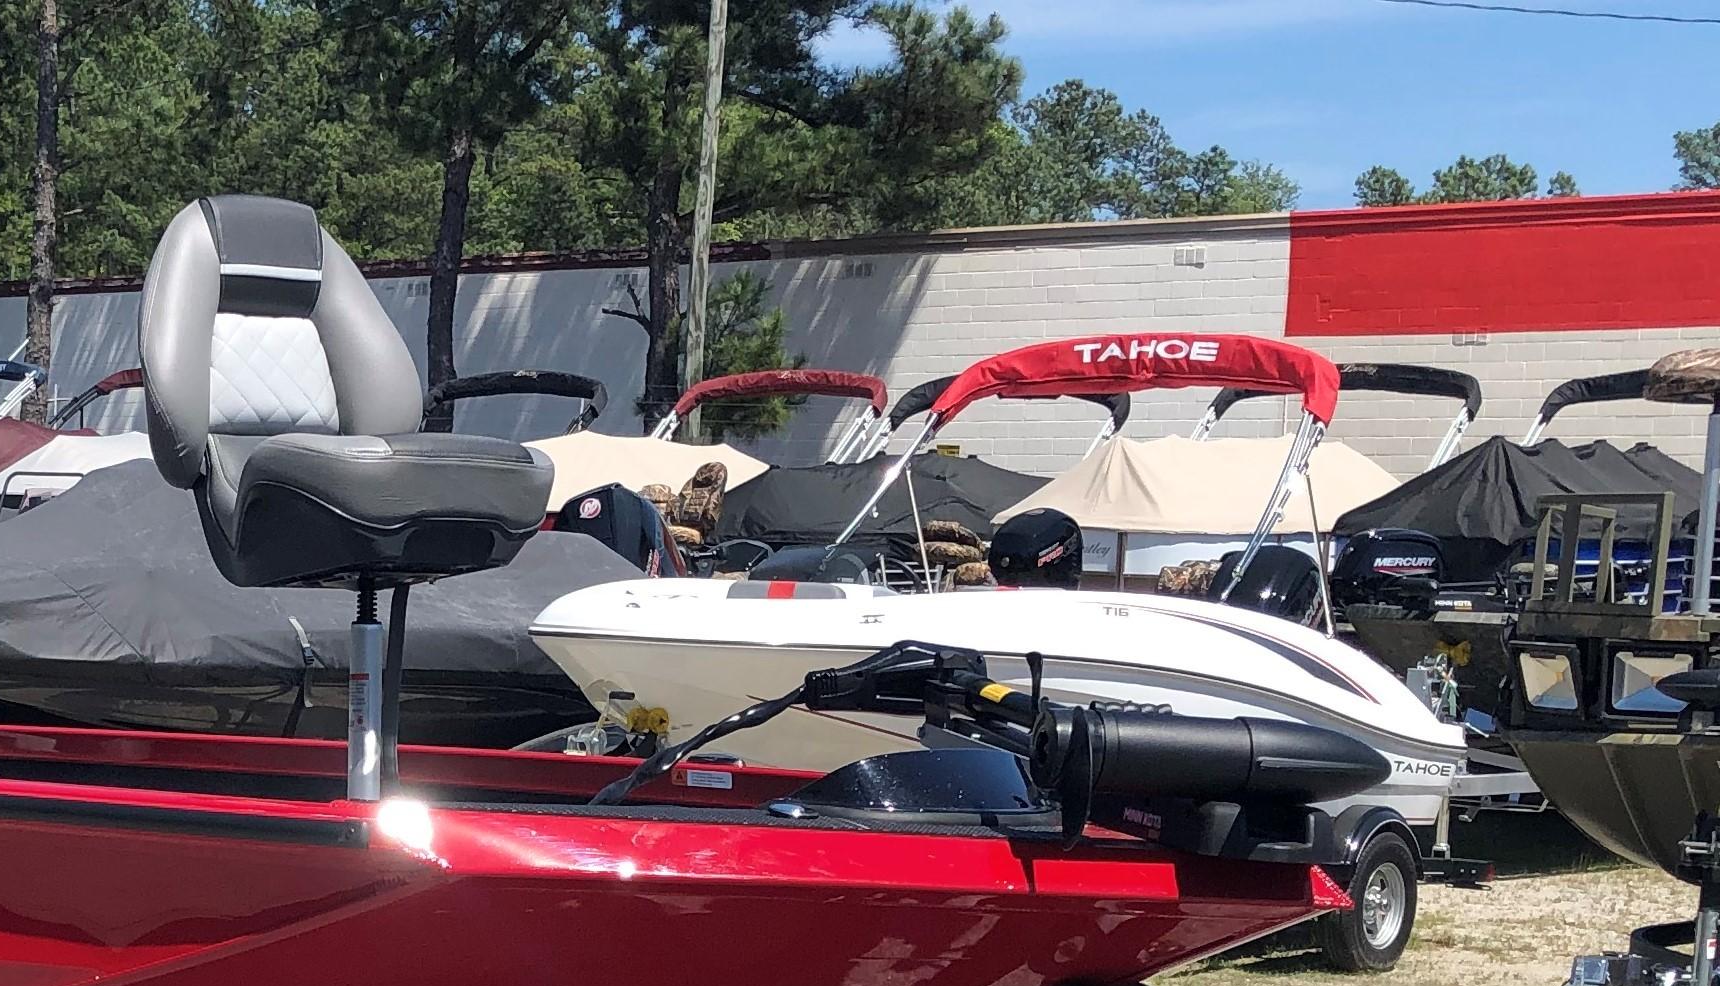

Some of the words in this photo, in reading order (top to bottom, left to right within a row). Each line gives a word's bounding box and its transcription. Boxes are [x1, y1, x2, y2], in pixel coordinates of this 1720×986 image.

[1073, 342, 1220, 362] TAHOE
[1373, 557, 1437, 568] MERCURY
[1103, 606, 1129, 617] T16
[1394, 760, 1451, 776] TAHOE
